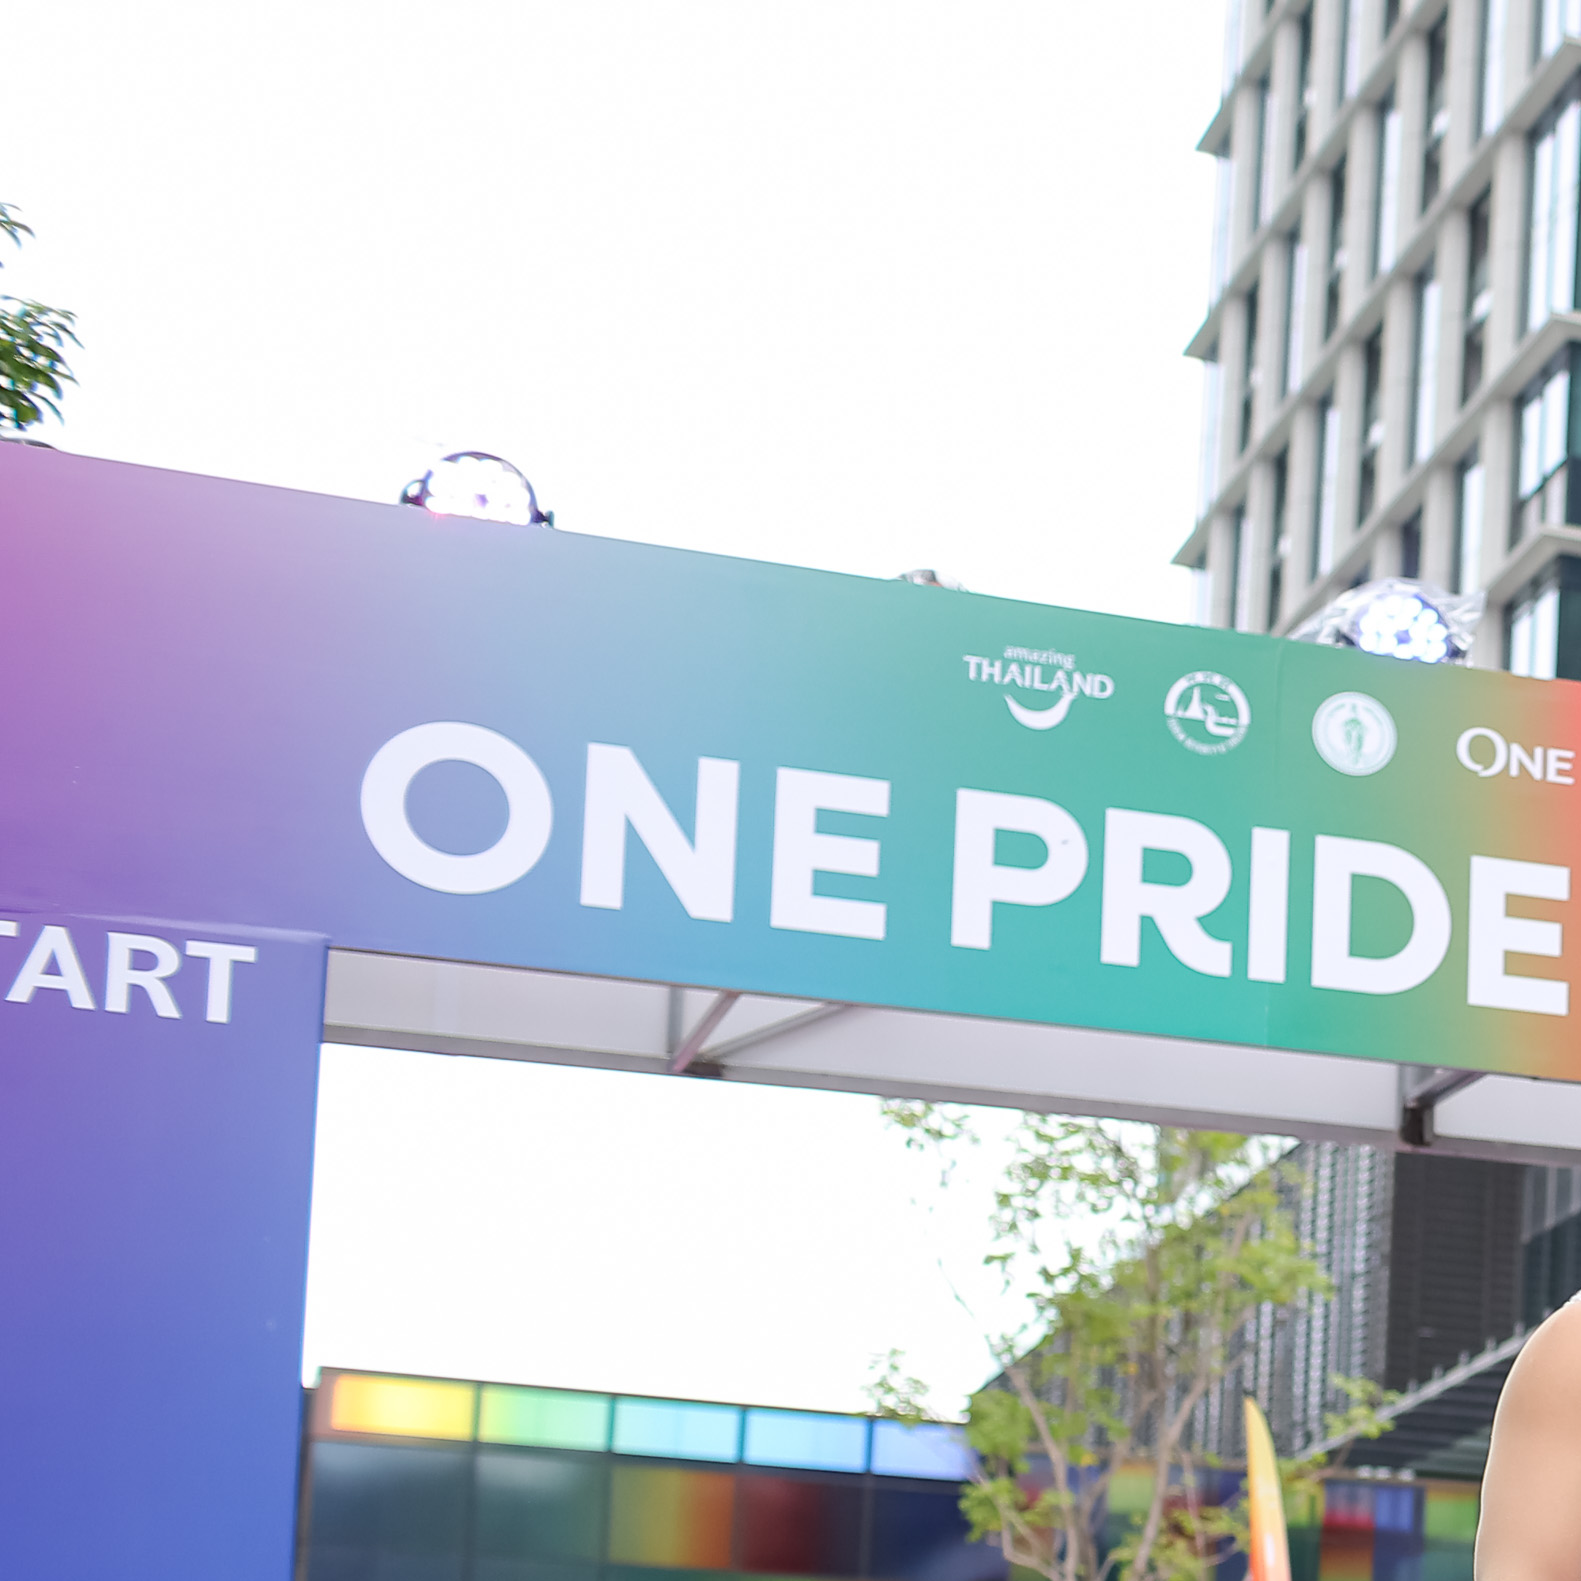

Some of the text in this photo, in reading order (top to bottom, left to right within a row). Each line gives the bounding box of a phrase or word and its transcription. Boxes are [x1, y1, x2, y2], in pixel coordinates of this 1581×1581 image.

[963, 654, 1115, 700] THAILAND
[1003, 645, 1075, 670] amazing
[1456, 727, 1576, 786] ONE
[359, 720, 890, 941] ONE
[951, 787, 1571, 1017] PRIDE
